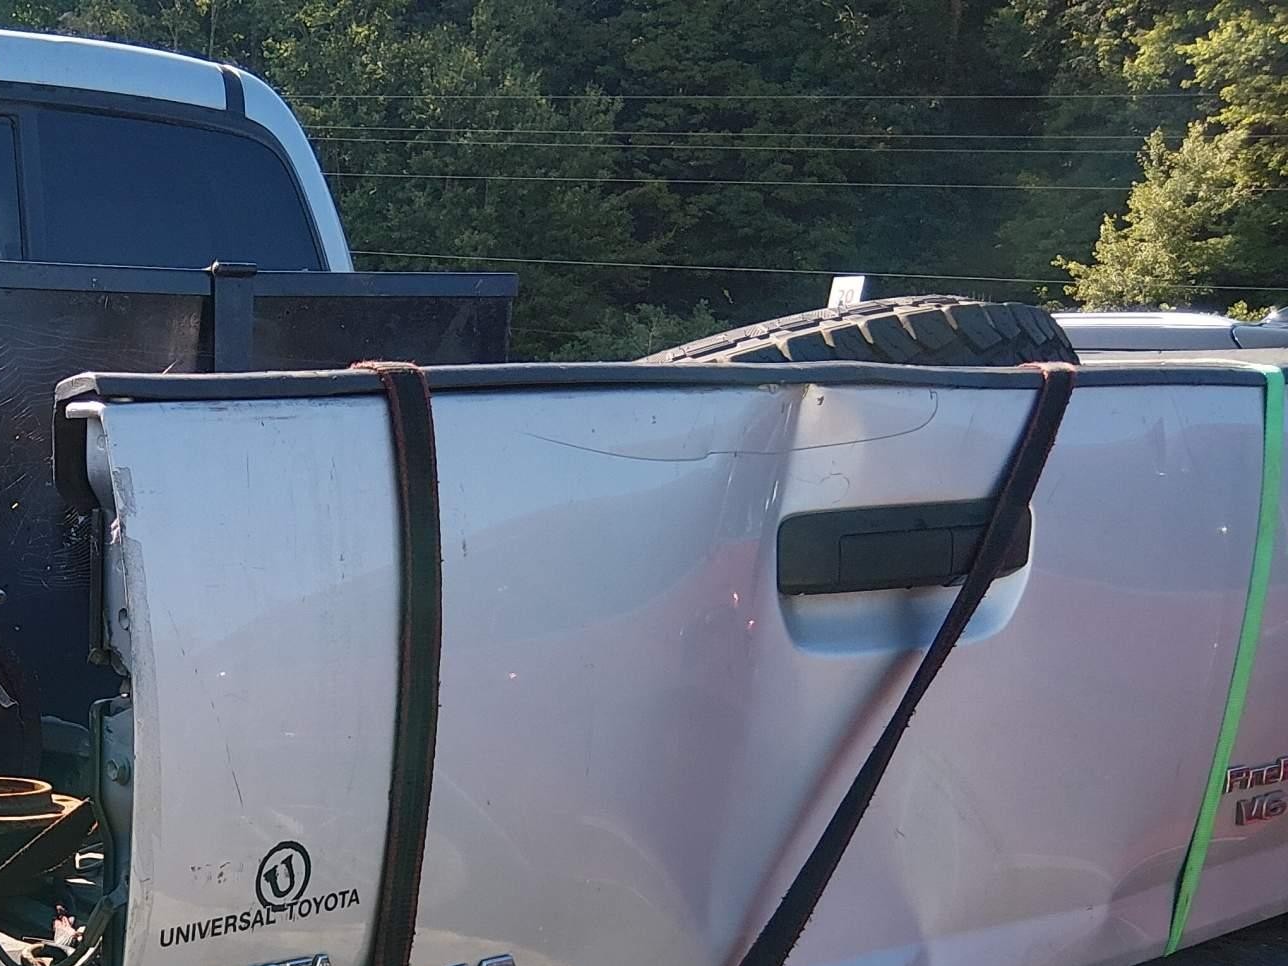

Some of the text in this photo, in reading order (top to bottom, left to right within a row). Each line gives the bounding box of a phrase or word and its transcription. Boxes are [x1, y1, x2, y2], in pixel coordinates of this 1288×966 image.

[1235, 790, 1288, 826] V6
[160, 889, 361, 948] UNIVERSAL TOYOTA
